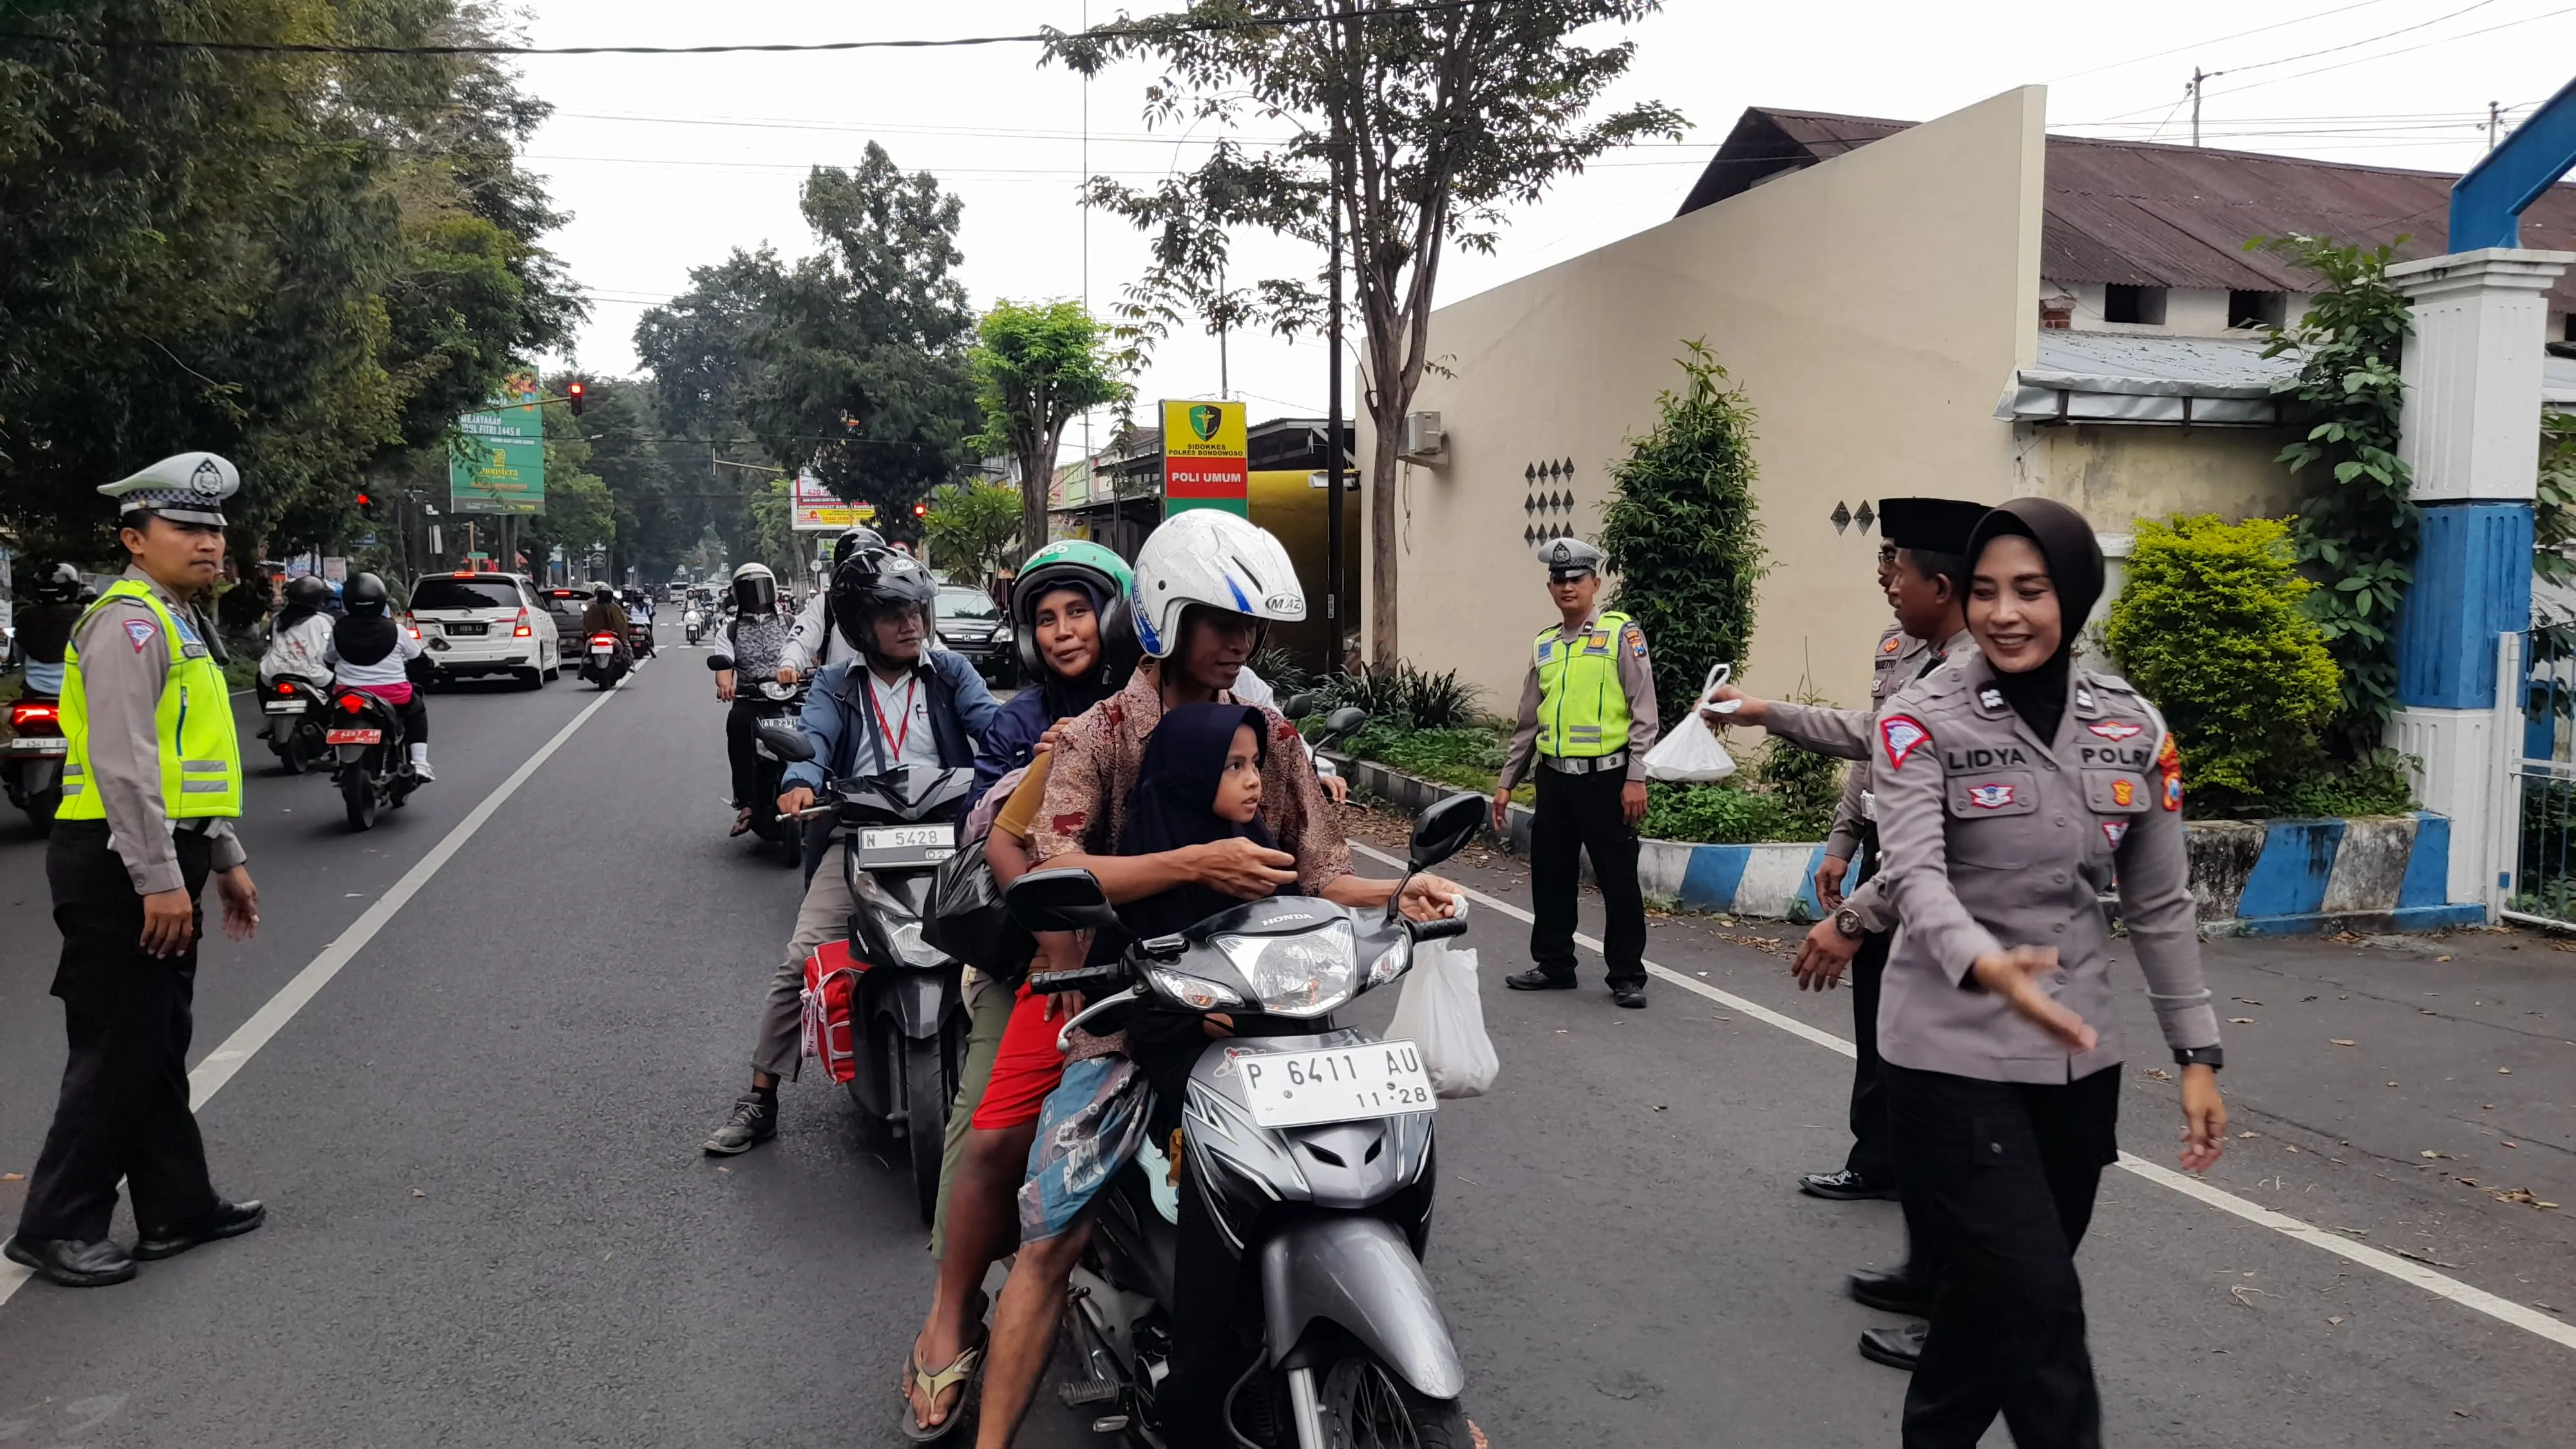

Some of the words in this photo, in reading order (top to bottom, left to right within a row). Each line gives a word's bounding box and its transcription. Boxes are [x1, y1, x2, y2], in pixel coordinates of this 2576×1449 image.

[479, 425, 496, 434] FITRI
[498, 426, 515, 435] 1445
[516, 428, 520, 436] H
[1172, 473, 1199, 482] POLI
[1203, 473, 1241, 482] UMUM
[1948, 748, 2027, 769] LIDYA
[2081, 747, 2151, 767] POLRI
[866, 834, 875, 847] N
[895, 831, 938, 845] 5428
[1262, 913, 1314, 926] HONDA
[1247, 1063, 1262, 1089] P
[1287, 1055, 1356, 1085] 6411
[1385, 1048, 1419, 1075] AU
